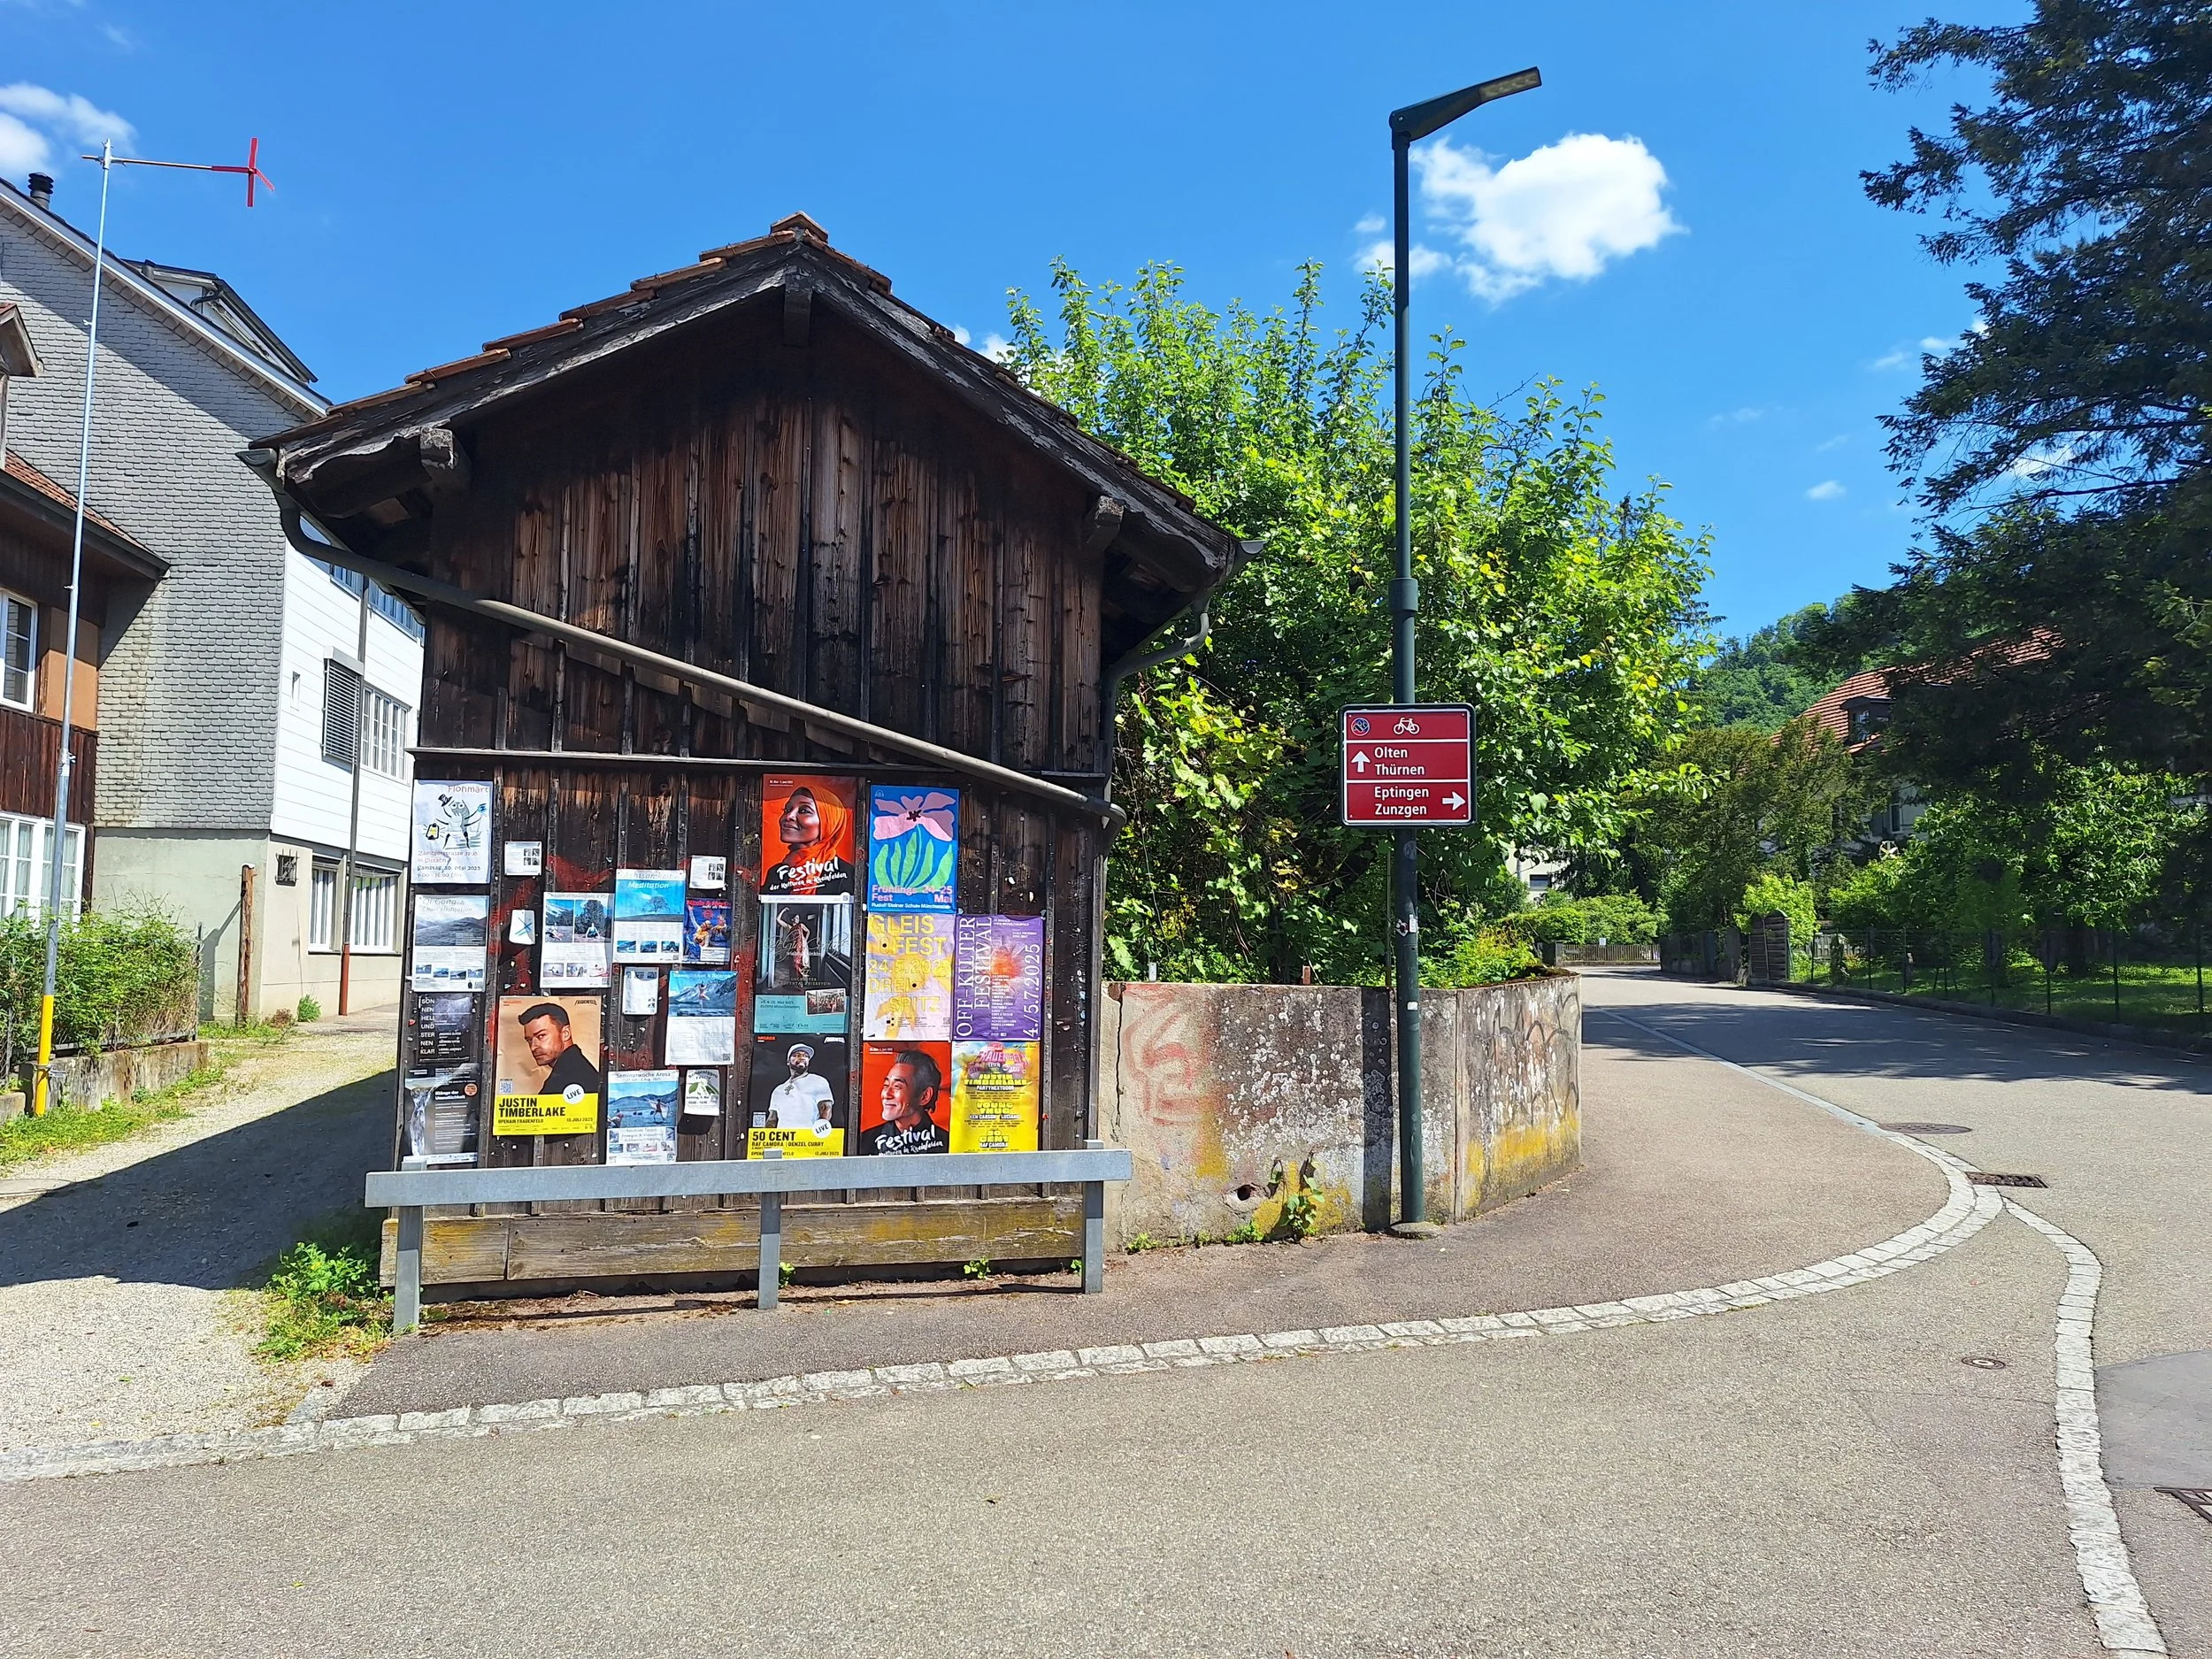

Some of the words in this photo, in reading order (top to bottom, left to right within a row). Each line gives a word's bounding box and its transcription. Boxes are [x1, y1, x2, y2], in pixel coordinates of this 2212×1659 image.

[1374, 747, 1408, 758] Olten
[1374, 764, 1425, 776] Thürnen
[1374, 786, 1430, 801] Eptingen
[1375, 803, 1427, 818] Zunzgen
[777, 856, 839, 880] Festival
[814, 872, 848, 883] Rheinfelden
[872, 885, 918, 895] Frühlings
[934, 895, 953, 903] Mai
[869, 915, 935, 934] GLEIS
[868, 959, 951, 974] 24.5.2025
[974, 917, 993, 1010] FESTIVAL
[956, 917, 976, 1037] OFF-KILTER
[1023, 944, 1041, 1038] 4./5.7.2025
[889, 996, 941, 1013] SPITZ
[567, 1088, 582, 1100] LIVE
[498, 1098, 538, 1107] JUSTIN
[499, 1107, 566, 1118] TIMBERLAKE
[815, 1123, 829, 1134] LIVE
[753, 1132, 765, 1141] 50
[769, 1132, 796, 1141] CENT
[875, 1125, 935, 1150] Festival
[910, 1141, 944, 1153] Rheinfelden
